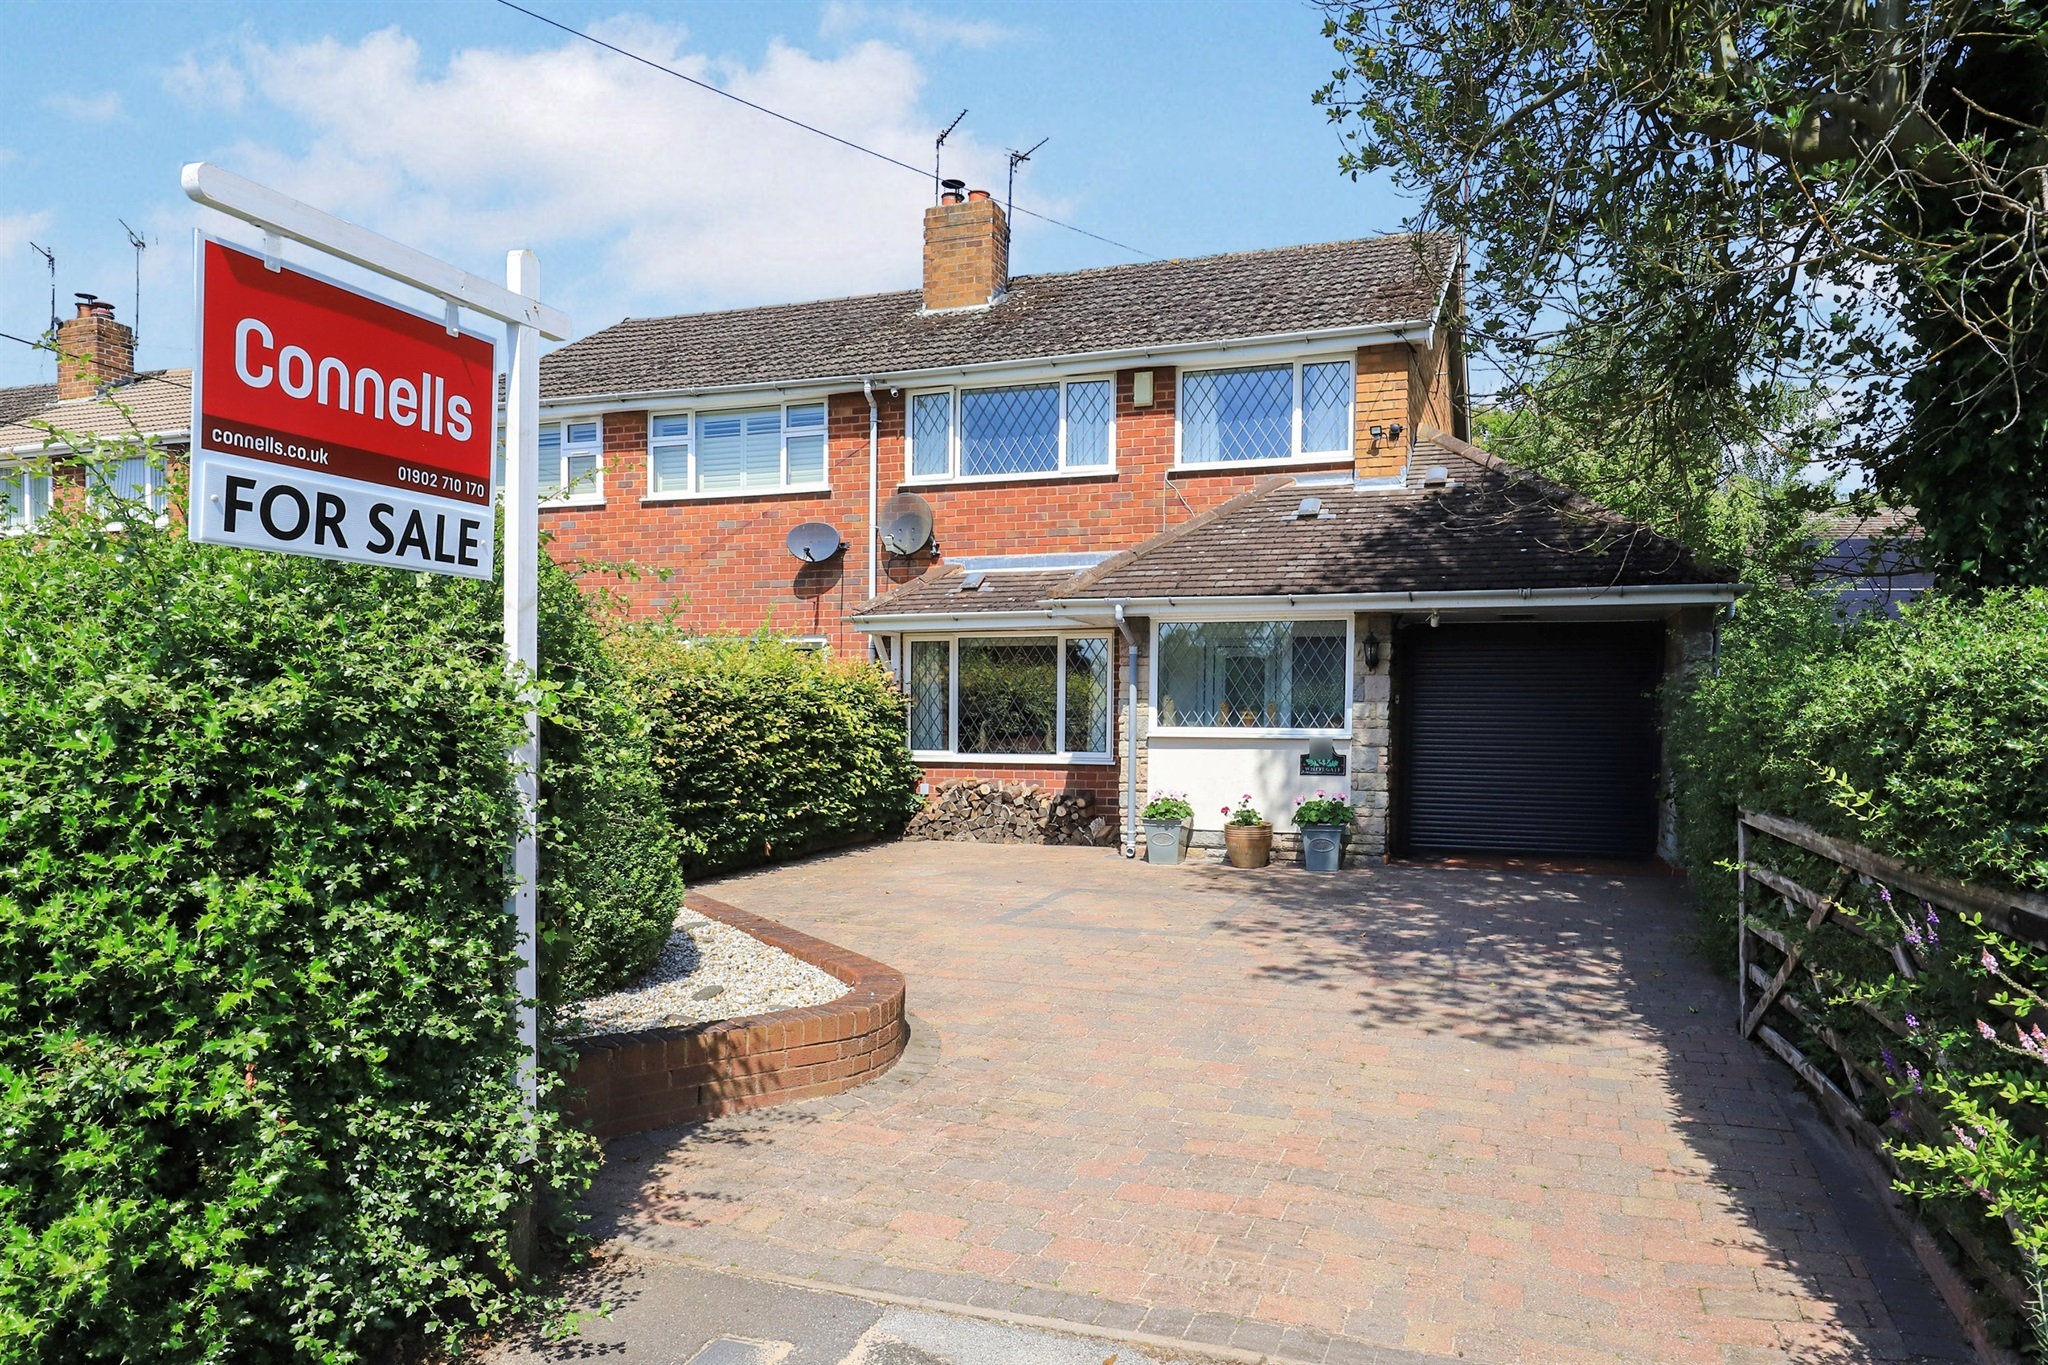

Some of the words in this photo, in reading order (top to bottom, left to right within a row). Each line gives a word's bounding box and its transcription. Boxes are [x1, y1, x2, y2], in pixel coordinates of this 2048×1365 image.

[235, 318, 473, 442] Connells
[212, 427, 329, 466] connells.co.uk
[397, 466, 438, 488] 01902
[442, 475, 462, 493] 710
[465, 480, 485, 498] 170
[223, 475, 349, 549] FOR
[366, 502, 480, 567] SALE
